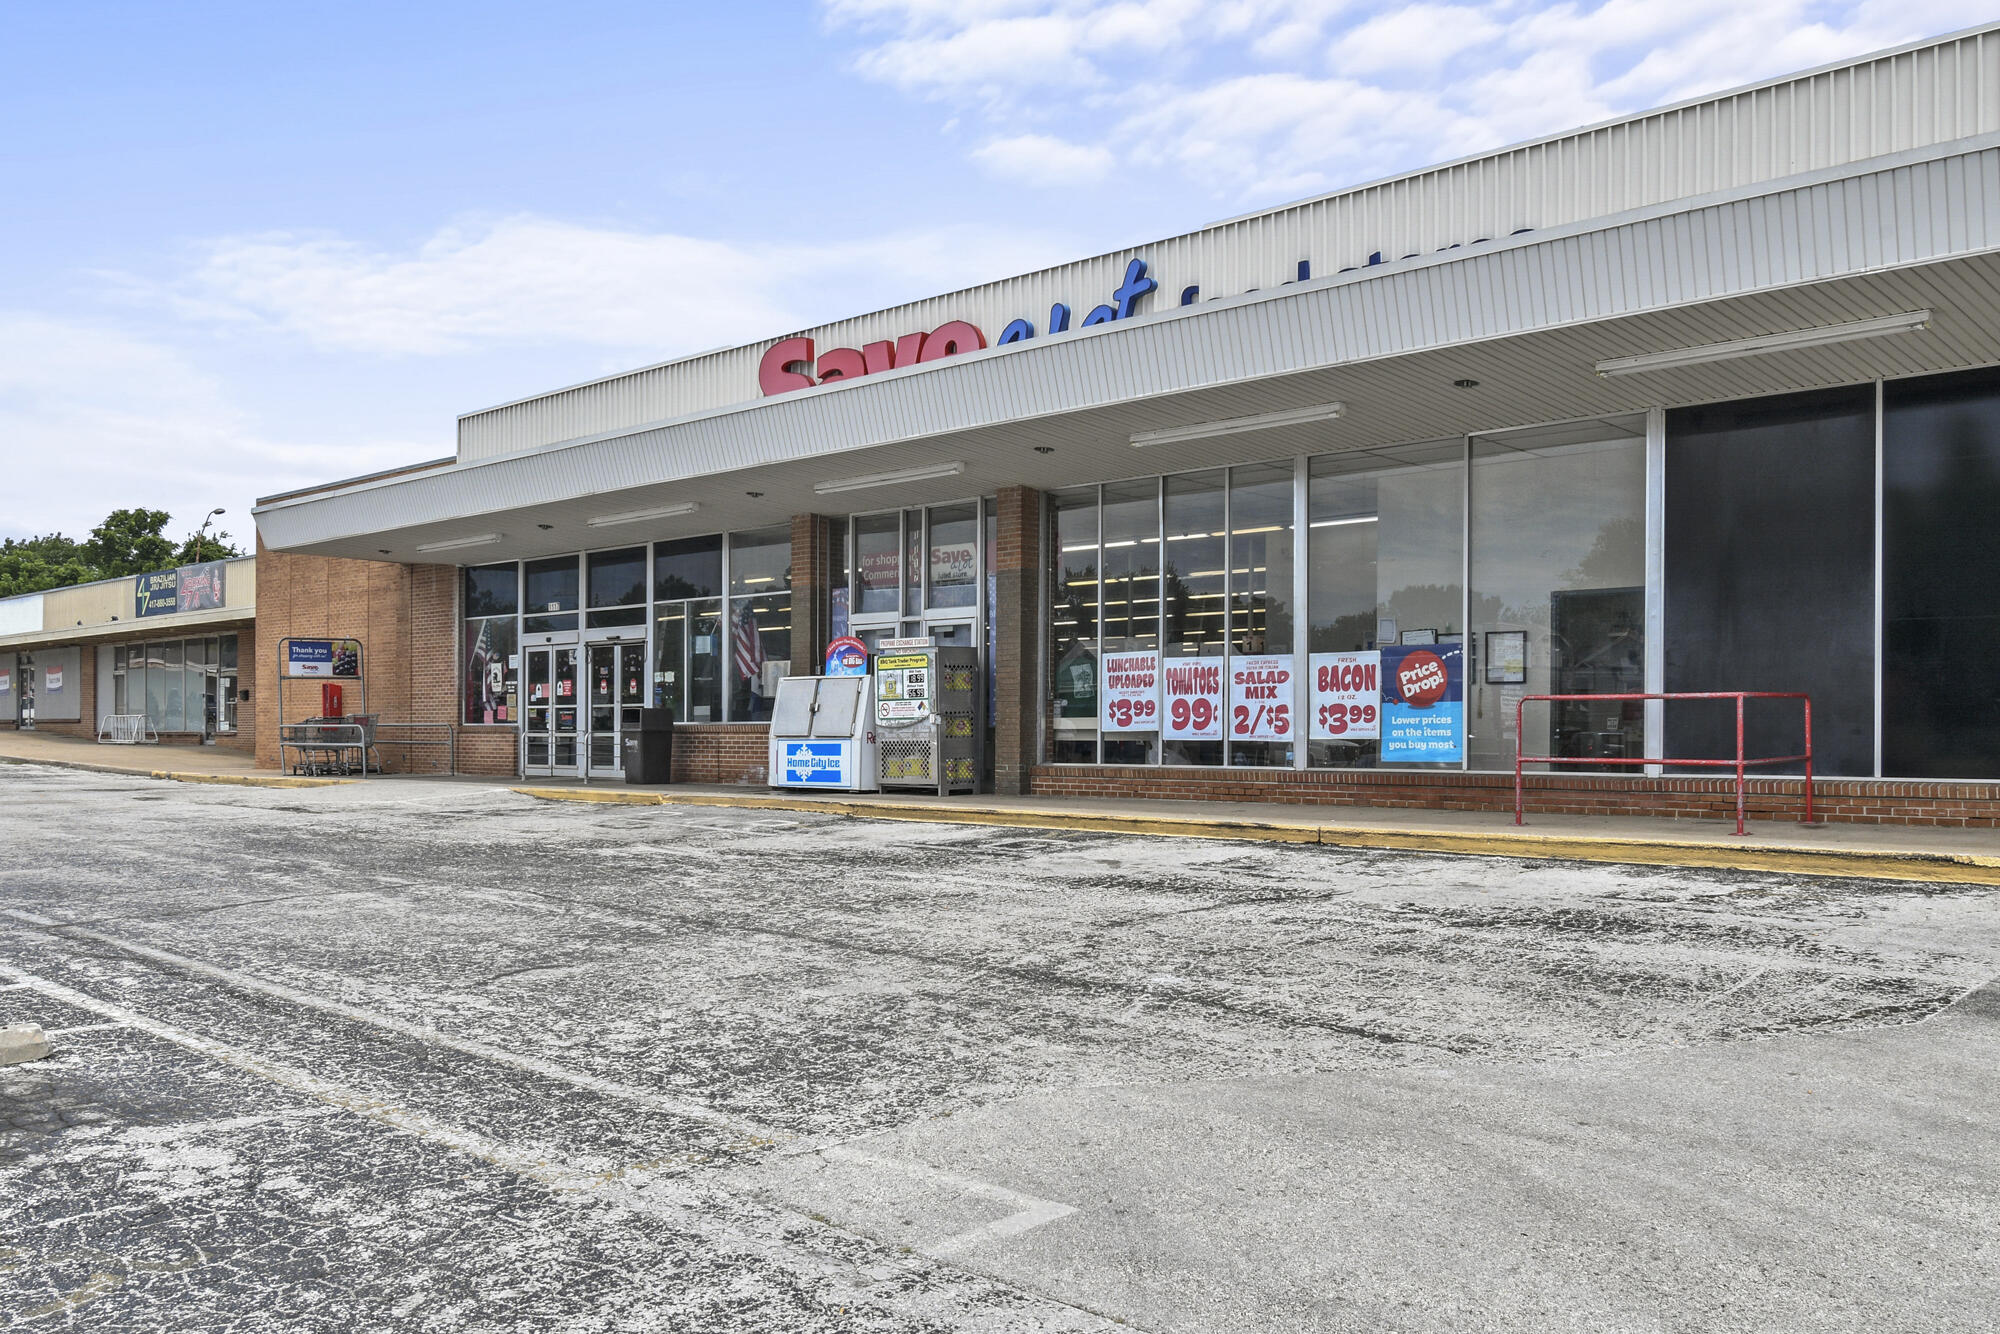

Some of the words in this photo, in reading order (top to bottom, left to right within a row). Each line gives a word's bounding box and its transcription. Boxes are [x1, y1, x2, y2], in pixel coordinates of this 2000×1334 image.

[931, 548, 972, 565] Save
[150, 572, 176, 585] BRAZILIAN
[160, 580, 176, 590] JITSU
[292, 646, 313, 654] Thank
[1106, 656, 1156, 673] LUNCHABLE
[1234, 670, 1290, 685] SALAD
[1317, 663, 1376, 692] BACON
[1399, 661, 1439, 684] Price
[1108, 673, 1155, 689] UPLOADED
[1165, 666, 1219, 696] TOMATOES
[1402, 670, 1444, 698] Drop!
[1245, 685, 1278, 699] MIX
[1234, 704, 1290, 735] 2/$5
[1391, 716, 1421, 725] Lower
[1421, 714, 1452, 728] prices
[1391, 728, 1405, 736] on
[1405, 727, 1422, 736] the
[1423, 726, 1452, 736] items
[1388, 741, 1407, 750] you
[1408, 739, 1427, 750] buy
[787, 757, 810, 768] Home
[810, 757, 827, 769] City
[827, 758, 840, 768] Ice
